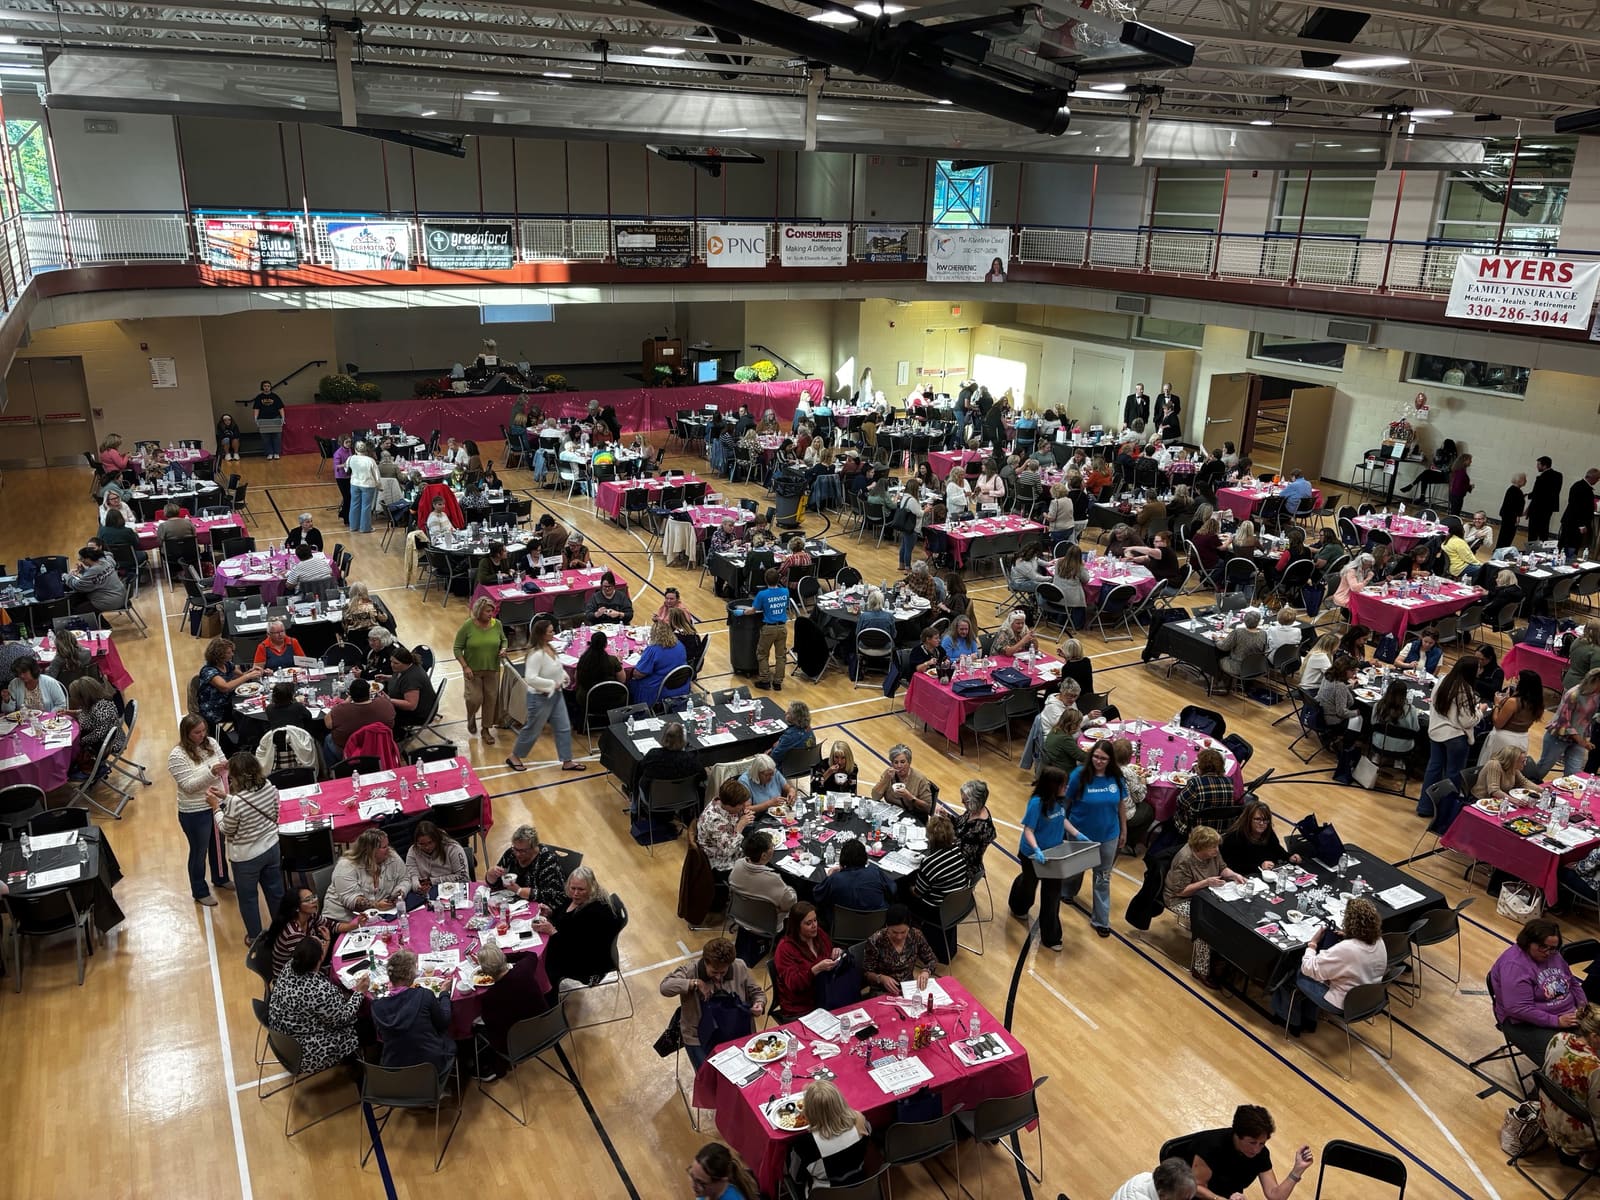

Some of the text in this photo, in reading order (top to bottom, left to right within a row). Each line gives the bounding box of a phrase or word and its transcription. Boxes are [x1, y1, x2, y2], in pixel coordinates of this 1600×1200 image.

[451, 231, 508, 246] greenford
[785, 228, 842, 239] CONSUMERS
[261, 241, 290, 251] BUILD
[727, 238, 765, 253] PNC
[785, 245, 806, 253] Making
[813, 244, 842, 252] Difference
[1478, 258, 1575, 283] MYERS
[1467, 284, 1578, 300] FAMILY INSURANCE
[1464, 294, 1496, 303] Medicare
[1502, 298, 1527, 306] Health
[1533, 301, 1577, 310] Retirement
[1466, 303, 1569, 325] 330-286-3044
